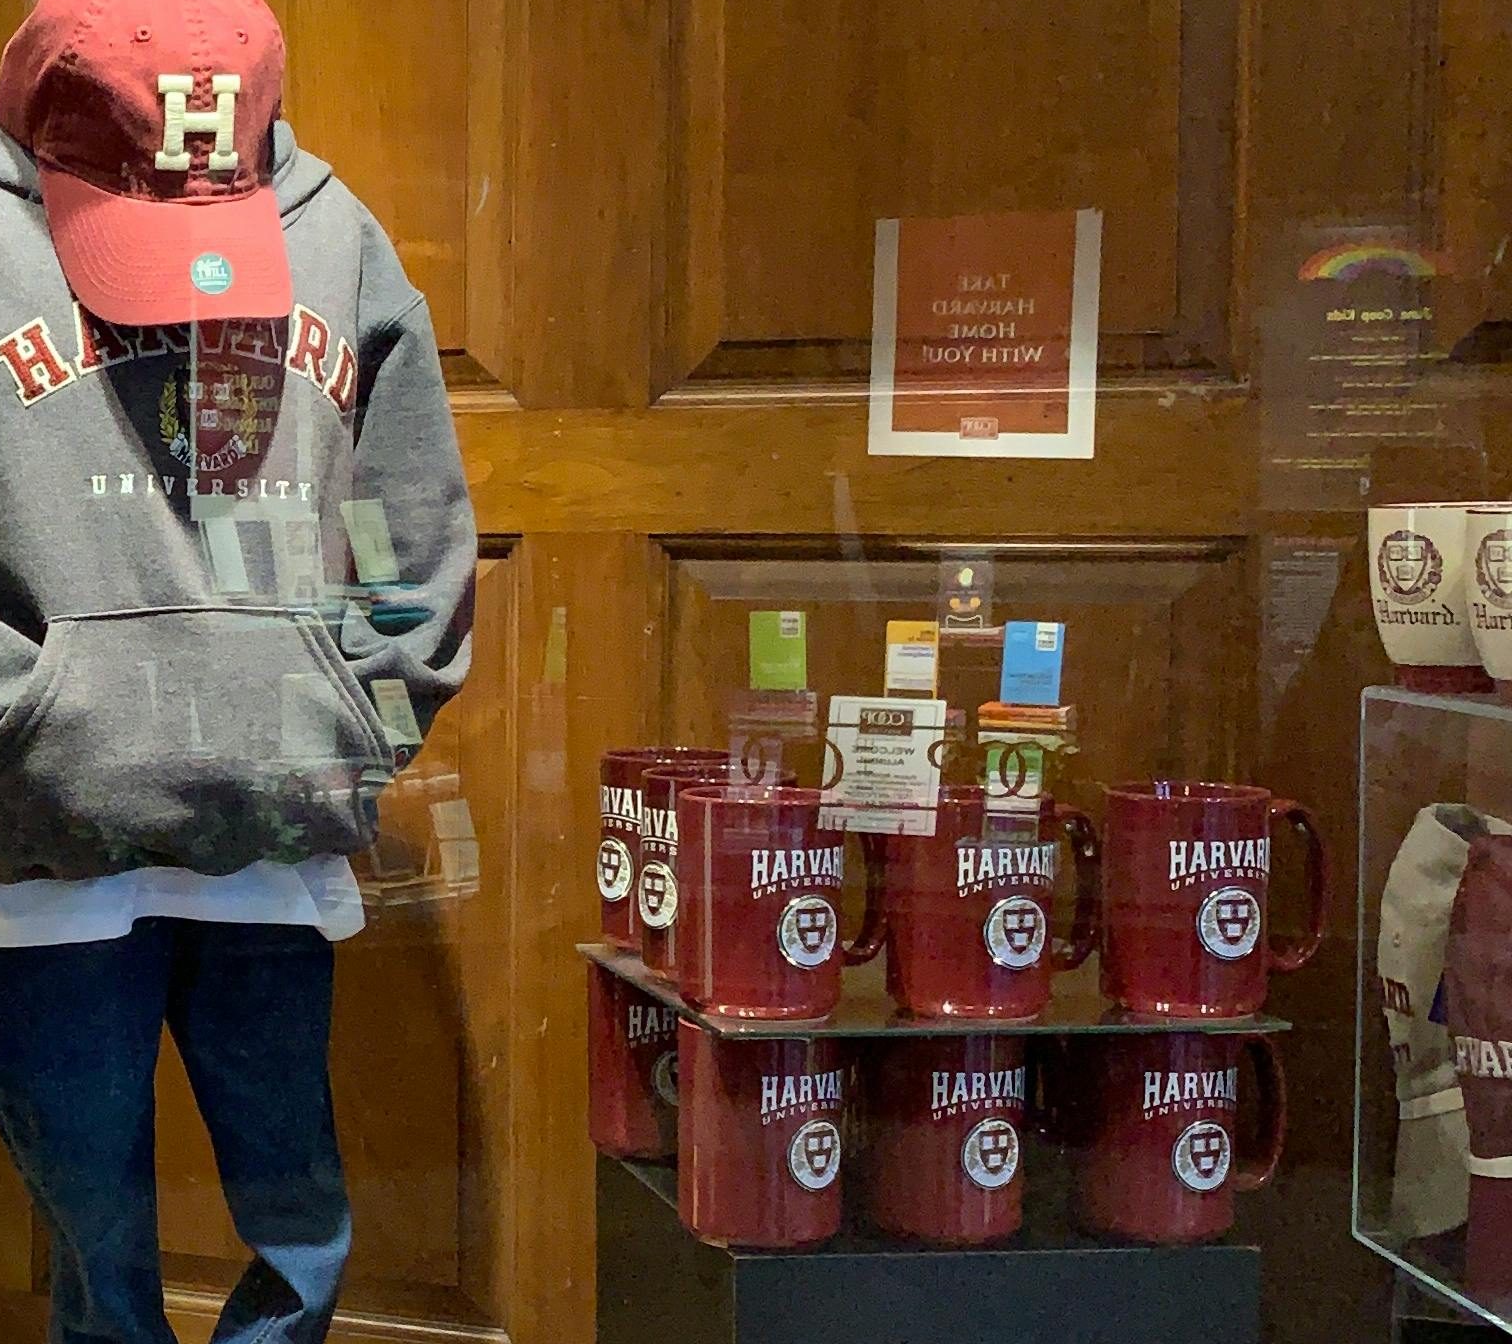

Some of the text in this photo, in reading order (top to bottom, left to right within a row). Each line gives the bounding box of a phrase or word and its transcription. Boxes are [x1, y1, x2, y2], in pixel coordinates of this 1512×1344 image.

[155, 74, 242, 170] H
[176, 444, 241, 471] HAVARD
[92, 474, 313, 501] UNIVERSITY
[751, 846, 843, 888] HARVAR
